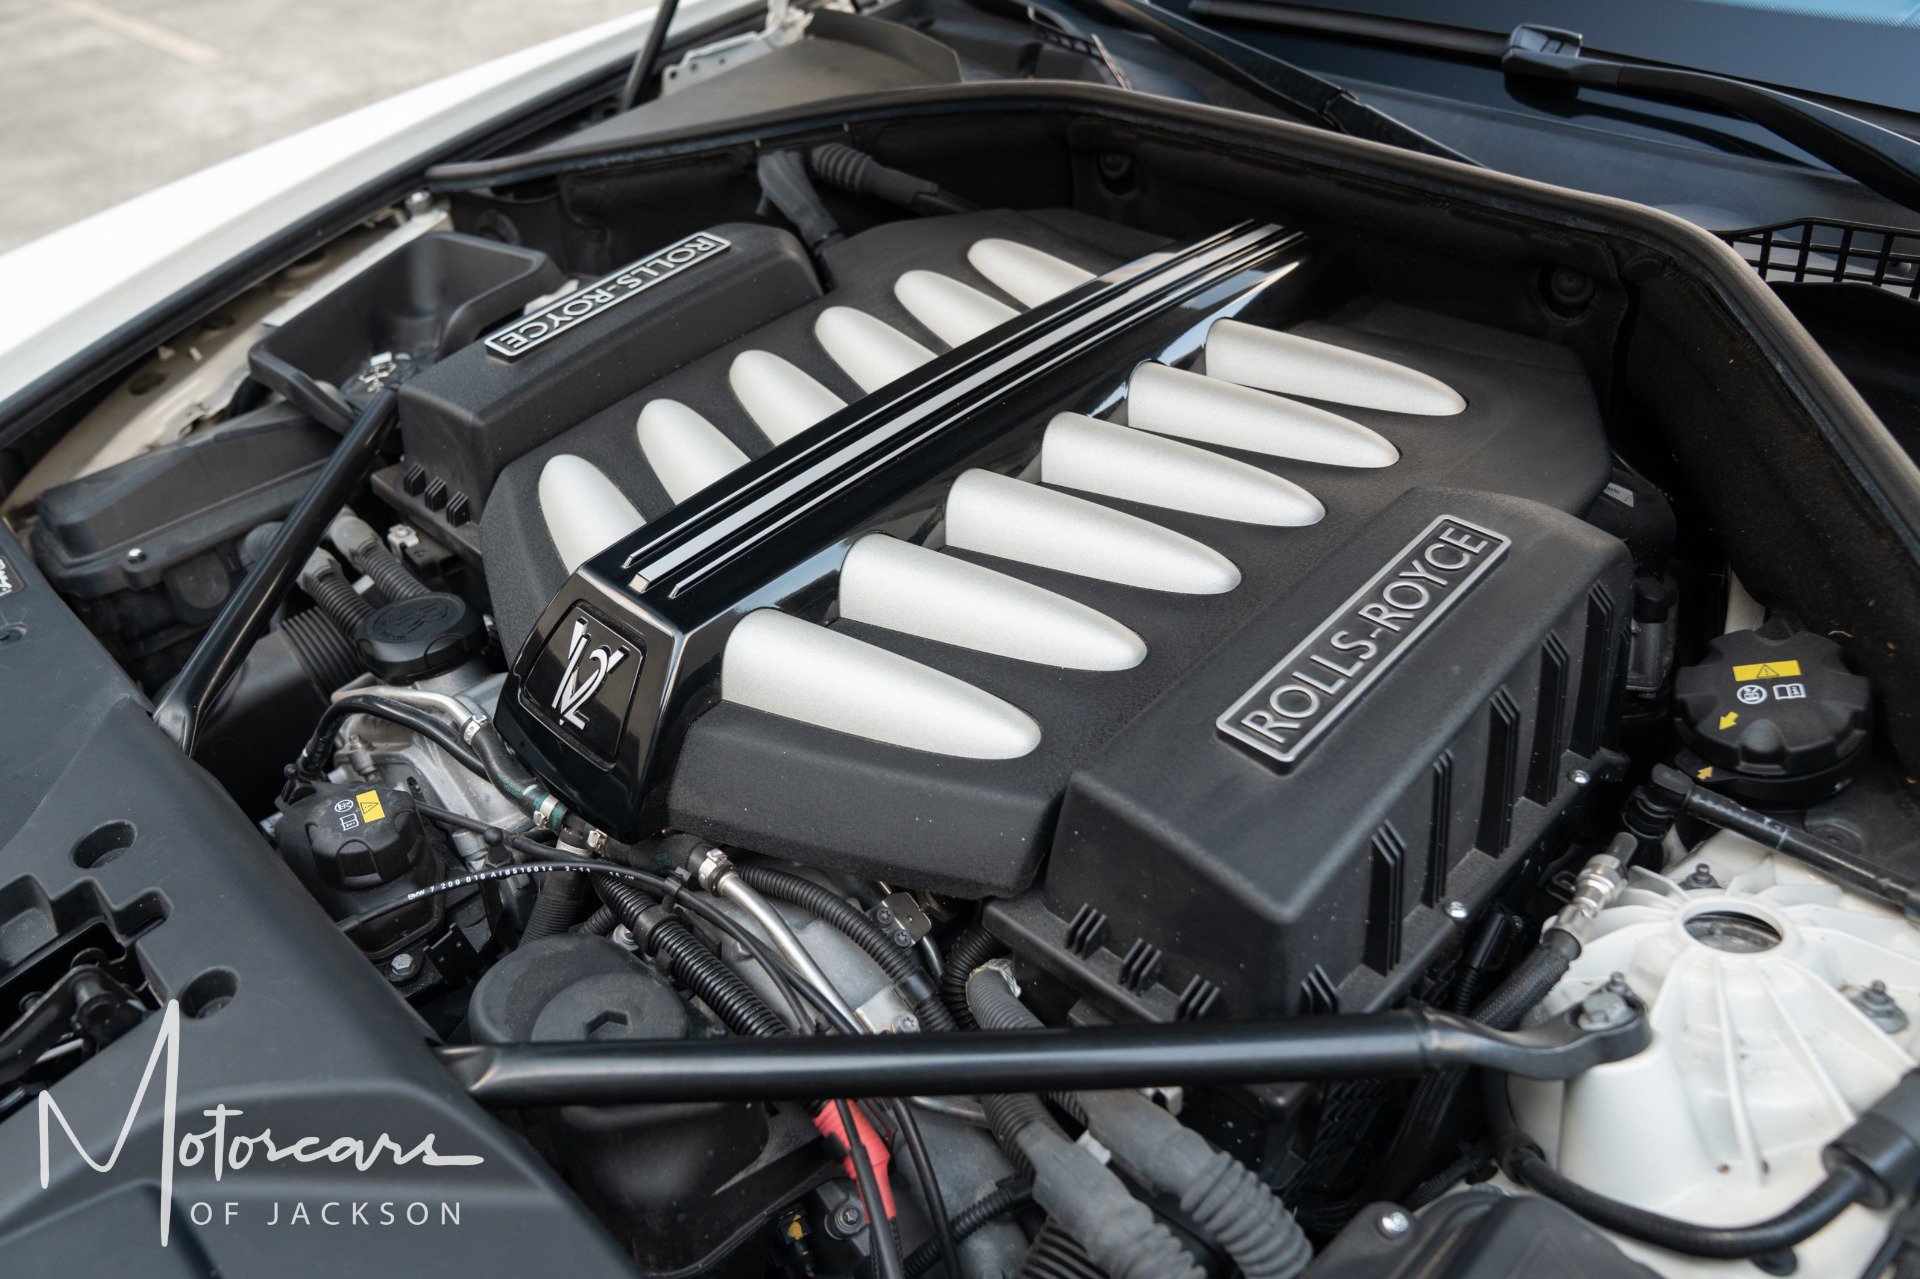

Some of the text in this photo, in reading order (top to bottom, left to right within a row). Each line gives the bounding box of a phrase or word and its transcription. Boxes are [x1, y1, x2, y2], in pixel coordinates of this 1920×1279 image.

[500, 237, 717, 349] ROLLS-ROYCE
[1240, 527, 1490, 744] ROLLS-ROYCE
[407, 889, 426, 900] BMW
[440, 878, 461, 890] 200
